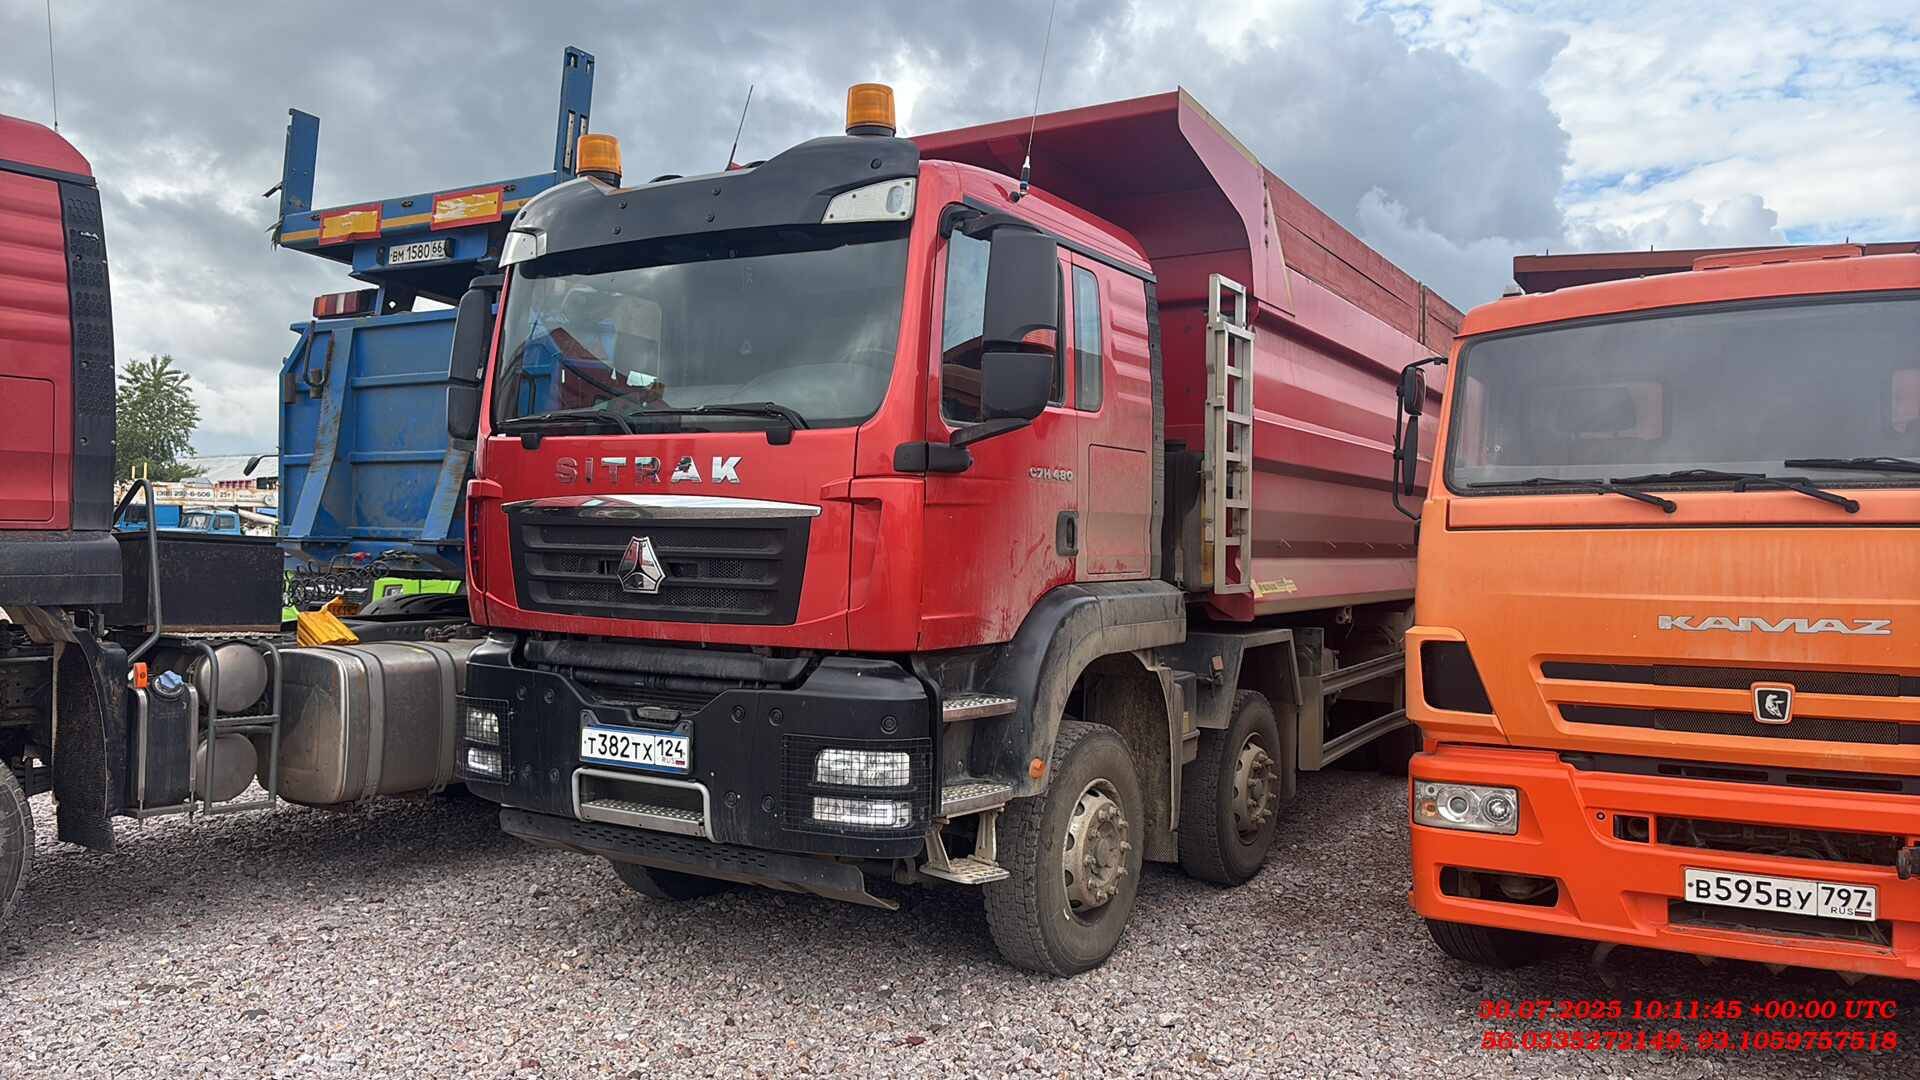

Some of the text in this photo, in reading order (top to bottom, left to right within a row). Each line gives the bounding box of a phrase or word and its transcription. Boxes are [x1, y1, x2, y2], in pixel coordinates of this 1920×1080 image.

[407, 244, 430, 260] 1580
[432, 242, 442, 254] 66
[555, 456, 742, 484] SITRAK
[1030, 467, 1073, 481] C7H 480
[1657, 615, 1892, 635] KAMAZ
[657, 739, 684, 758] 124
[1821, 886, 1868, 909] 797
[1830, 906, 1855, 916] RUS
